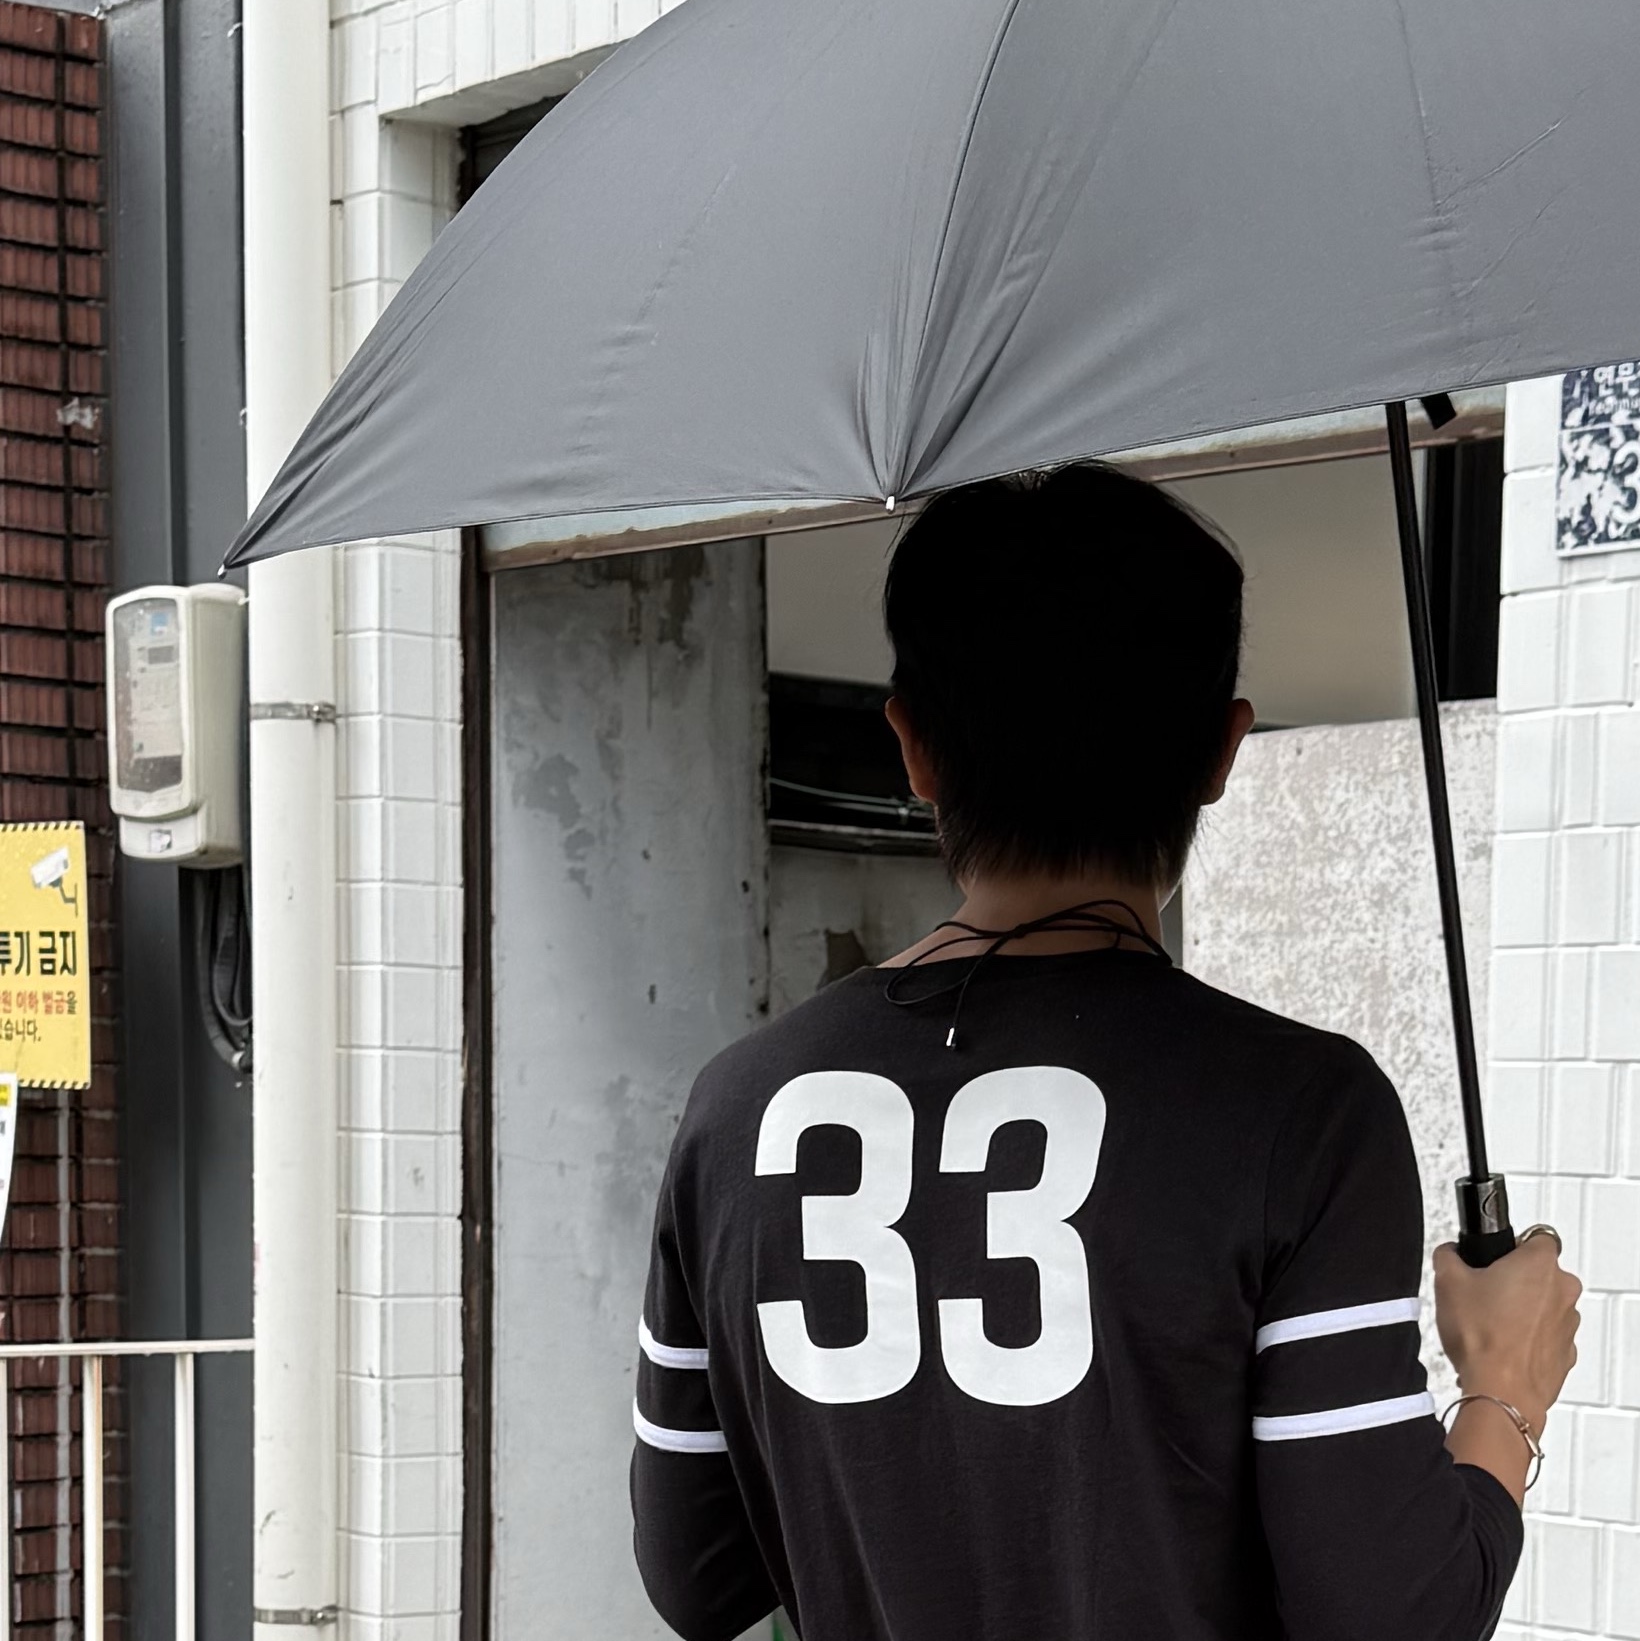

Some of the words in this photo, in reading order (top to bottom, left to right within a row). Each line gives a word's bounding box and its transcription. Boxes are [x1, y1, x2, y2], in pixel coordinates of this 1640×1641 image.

[38, 930, 77, 976] 금지
[16, 990, 39, 1014] 이하
[0, 1018, 42, 1043] 습니다.
[755, 1065, 1107, 1407] 33
